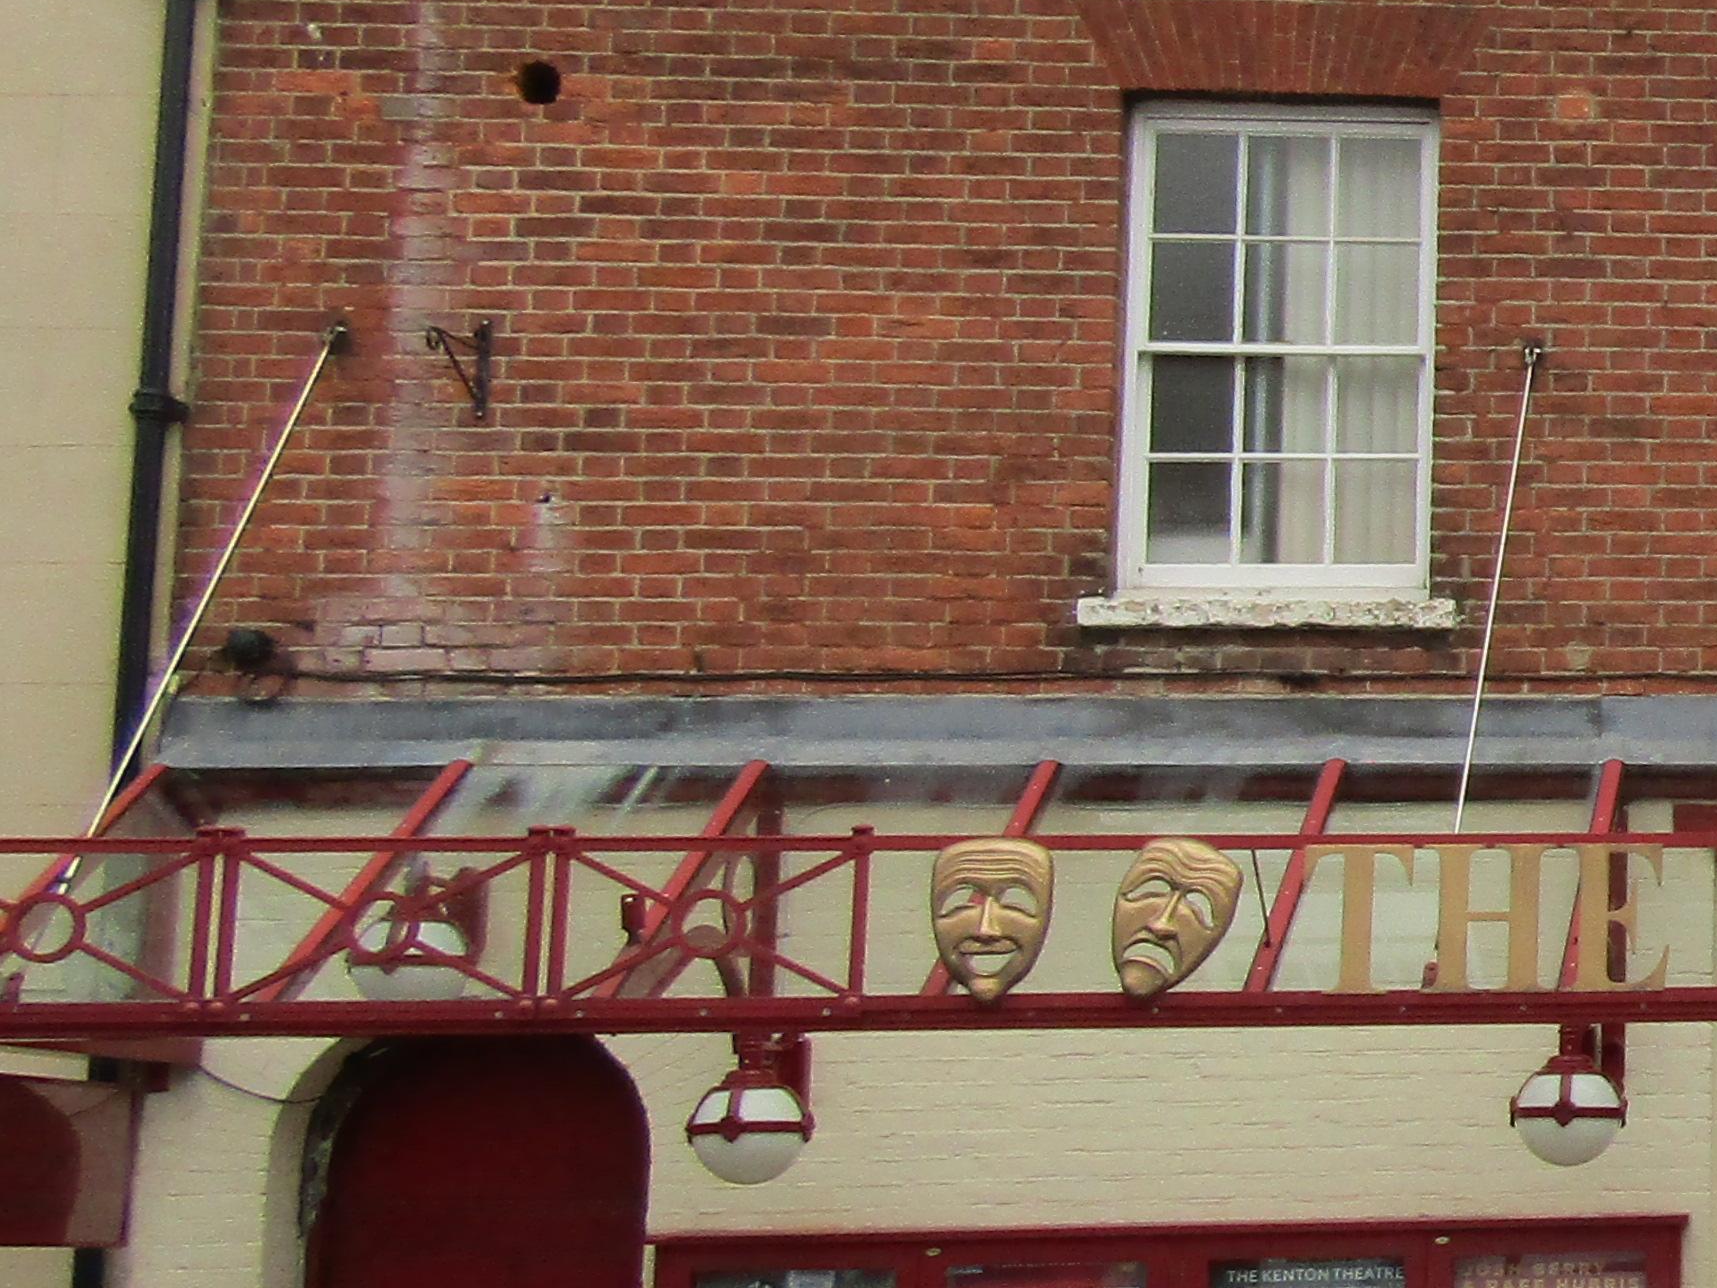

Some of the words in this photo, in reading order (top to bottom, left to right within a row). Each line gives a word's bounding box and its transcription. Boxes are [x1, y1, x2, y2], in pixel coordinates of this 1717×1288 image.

[1303, 842, 1671, 994] THE
[1227, 1269, 1257, 1283] THE
[1262, 1268, 1329, 1283] KENTON
[1334, 1266, 1404, 1281] THEATRE
